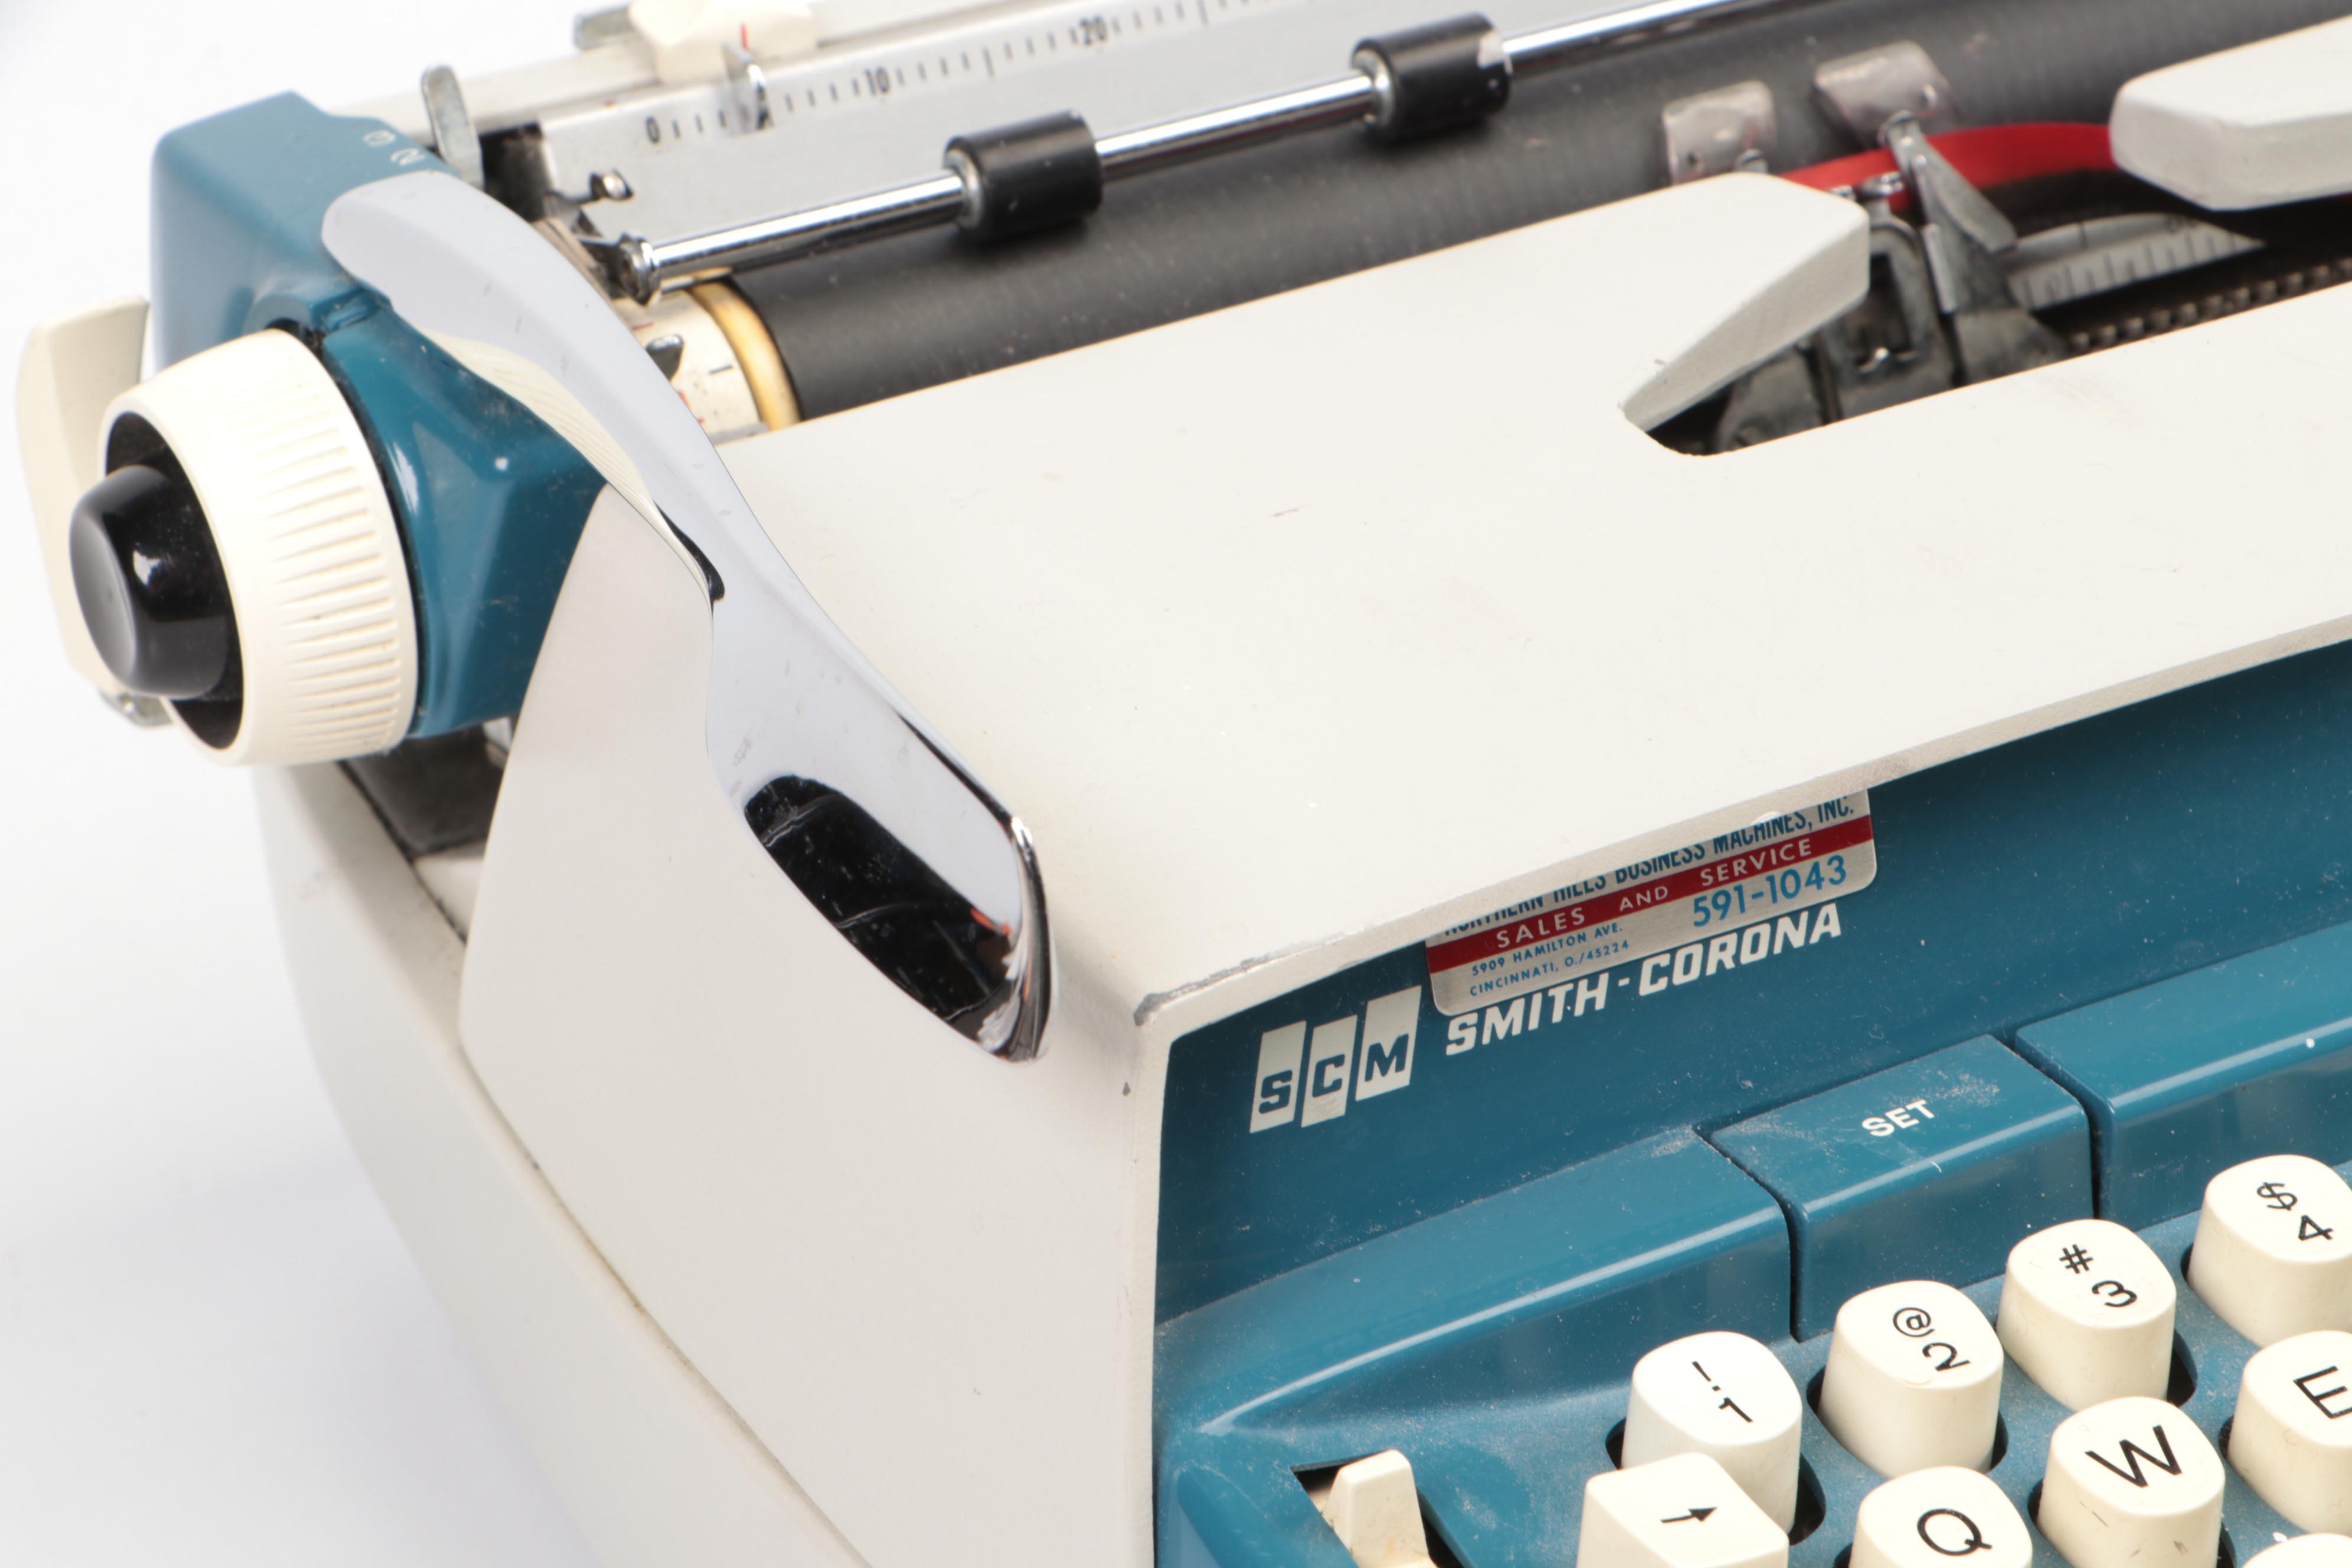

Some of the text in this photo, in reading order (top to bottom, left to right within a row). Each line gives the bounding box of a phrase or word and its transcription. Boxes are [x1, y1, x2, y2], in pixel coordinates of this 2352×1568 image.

[865, 66, 891, 95] 10
[1080, 15, 1108, 46] 20
[1497, 907, 1585, 949] SALES
[1619, 886, 1668, 912] AND
[1700, 838, 1812, 886] SERVICE
[1693, 854, 1847, 927] 591-1043
[1472, 922, 1622, 976] 5909 HAMILTON AVE.
[1470, 958, 1559, 996] CINCINNATI,
[1255, 1028, 1412, 1118] SCM
[1861, 1099, 1935, 1136] SET
[2256, 1182, 2298, 1211] $
[2298, 1214, 2334, 1241] 4
[2059, 1244, 2093, 1274] #
[2091, 1280, 2138, 1308] 3
[1892, 1306, 1935, 1338] @
[1922, 1342, 1971, 1371] 2
[1691, 1361, 1721, 1391] !
[2293, 1366, 2352, 1420] E
[1719, 1397, 1753, 1423] 1
[2083, 1424, 2183, 1488] W
[1916, 1508, 1993, 1556] Q
